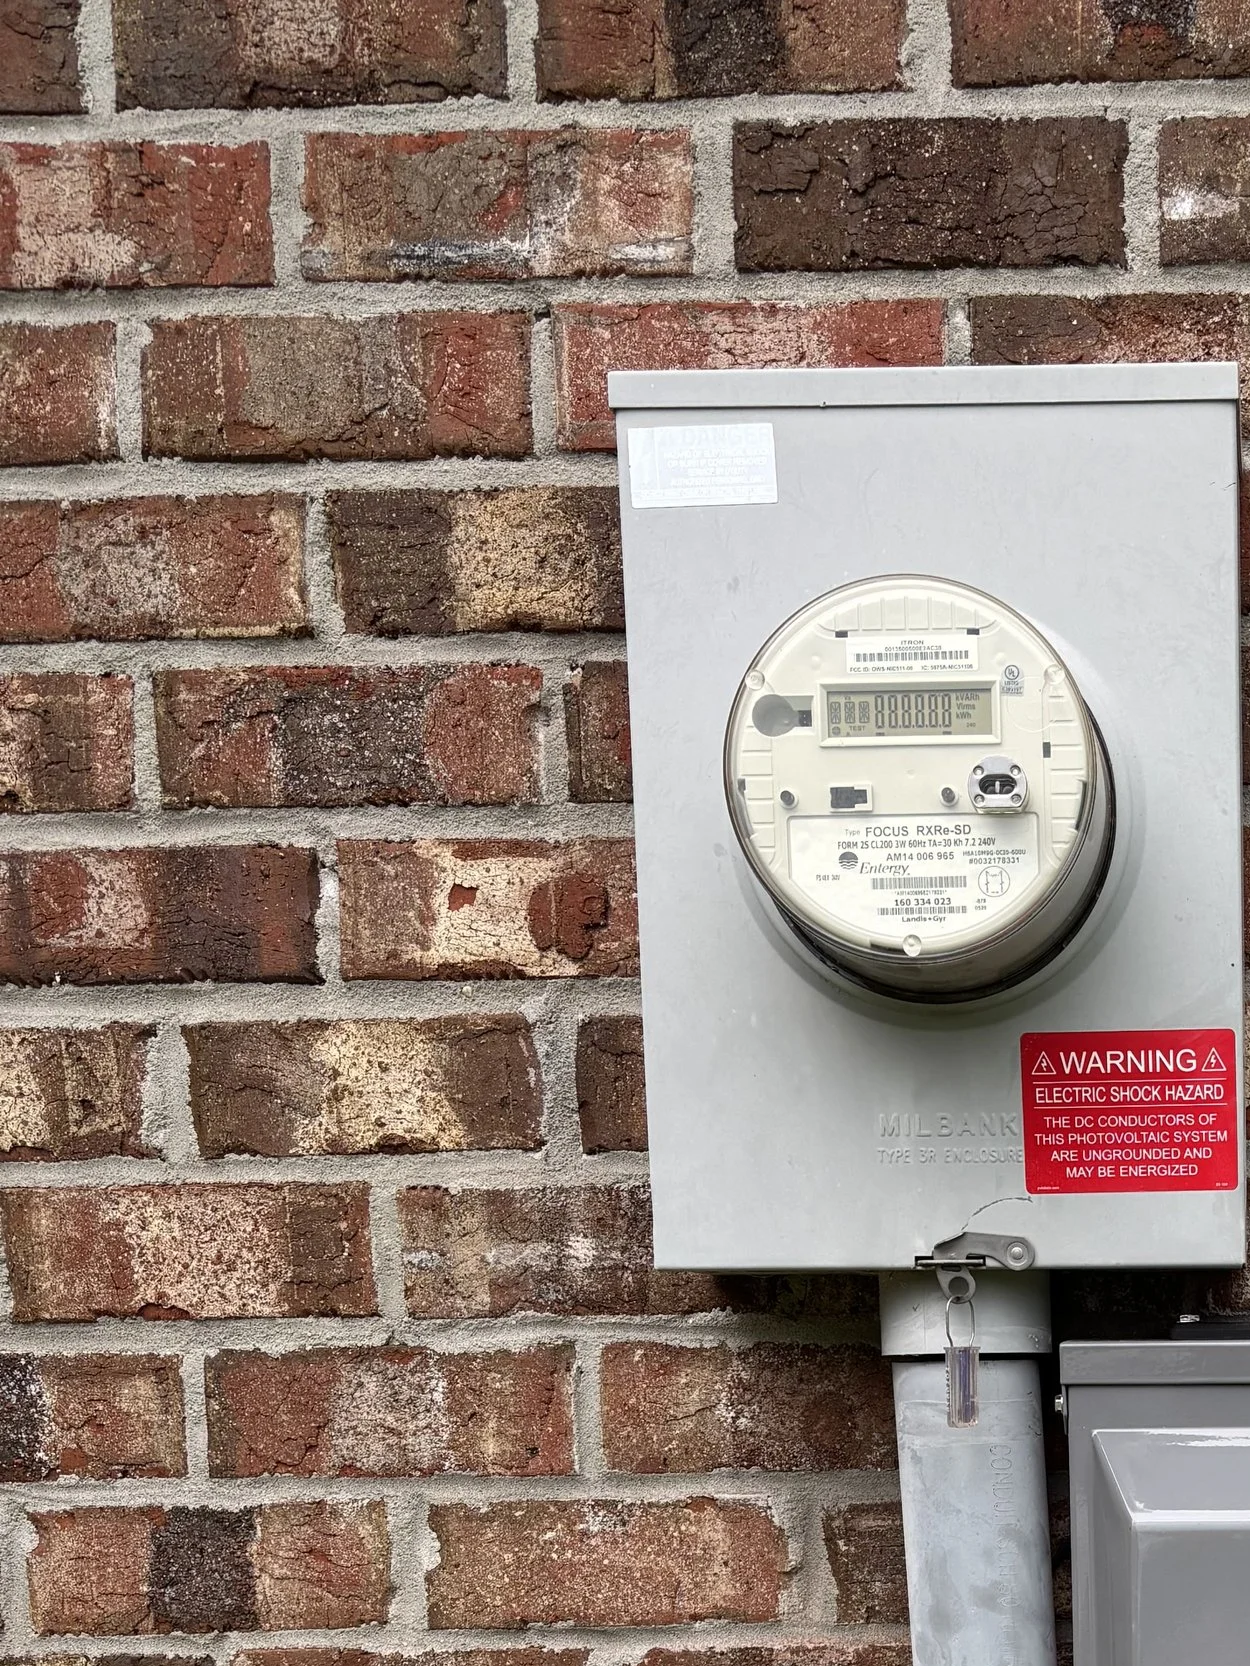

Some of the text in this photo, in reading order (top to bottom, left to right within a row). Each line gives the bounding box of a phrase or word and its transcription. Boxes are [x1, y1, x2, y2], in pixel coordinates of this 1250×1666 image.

[865, 826, 909, 837] FOCUS
[916, 824, 972, 836] RXRe-SD
[838, 841, 858, 850] FORM
[871, 840, 893, 849] CL200
[895, 840, 906, 848] 3W
[908, 839, 926, 848] 60Hz
[928, 839, 951, 848] TA=30
[964, 838, 976, 847] 7.2
[977, 837, 996, 846] 240V
[886, 851, 955, 861] AM14 006 965
[894, 897, 951, 907] 160 334 023
[1060, 1048, 1198, 1075] WARNING
[1035, 1084, 1224, 1104] ELECTRIC SHOCK HAZARD
[878, 1111, 1019, 1138] MILBANK
[1043, 1113, 1217, 1129] THE DC CONDUCTORS OF
[1034, 1130, 1228, 1146] THIS PHOTOVOLTAIC SYSTEM
[877, 1146, 1024, 1164] TYPE 3R ENCLOSURE
[1050, 1147, 1213, 1162] ARE UNGROUNDED AND
[1065, 1164, 1198, 1178] MAY BE ENERGIZED
